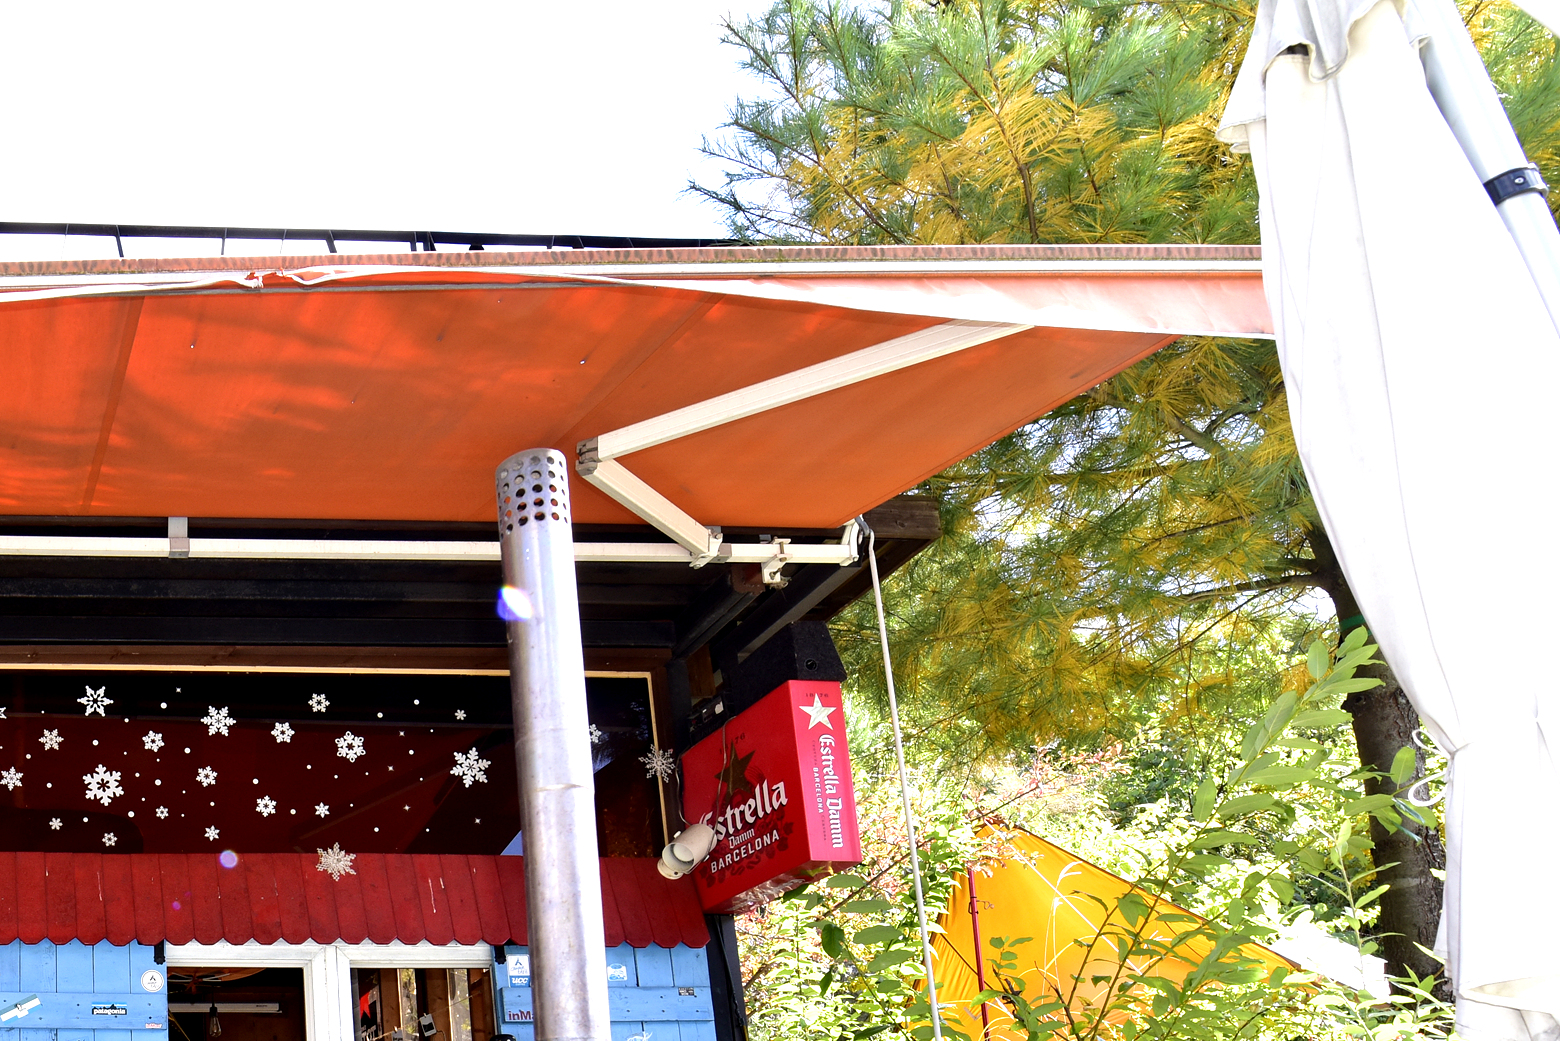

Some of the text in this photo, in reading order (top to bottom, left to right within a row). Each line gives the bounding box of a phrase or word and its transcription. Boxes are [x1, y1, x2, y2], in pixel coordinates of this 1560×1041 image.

[813, 766, 824, 814] BARCELONA
[819, 734, 844, 849] Estrella Damm
[698, 778, 789, 861] Estrella
[728, 827, 756, 850] Damm
[709, 829, 781, 874] BARCELONA
[93, 1008, 126, 1016] patagonia
[507, 1010, 534, 1021] inM
